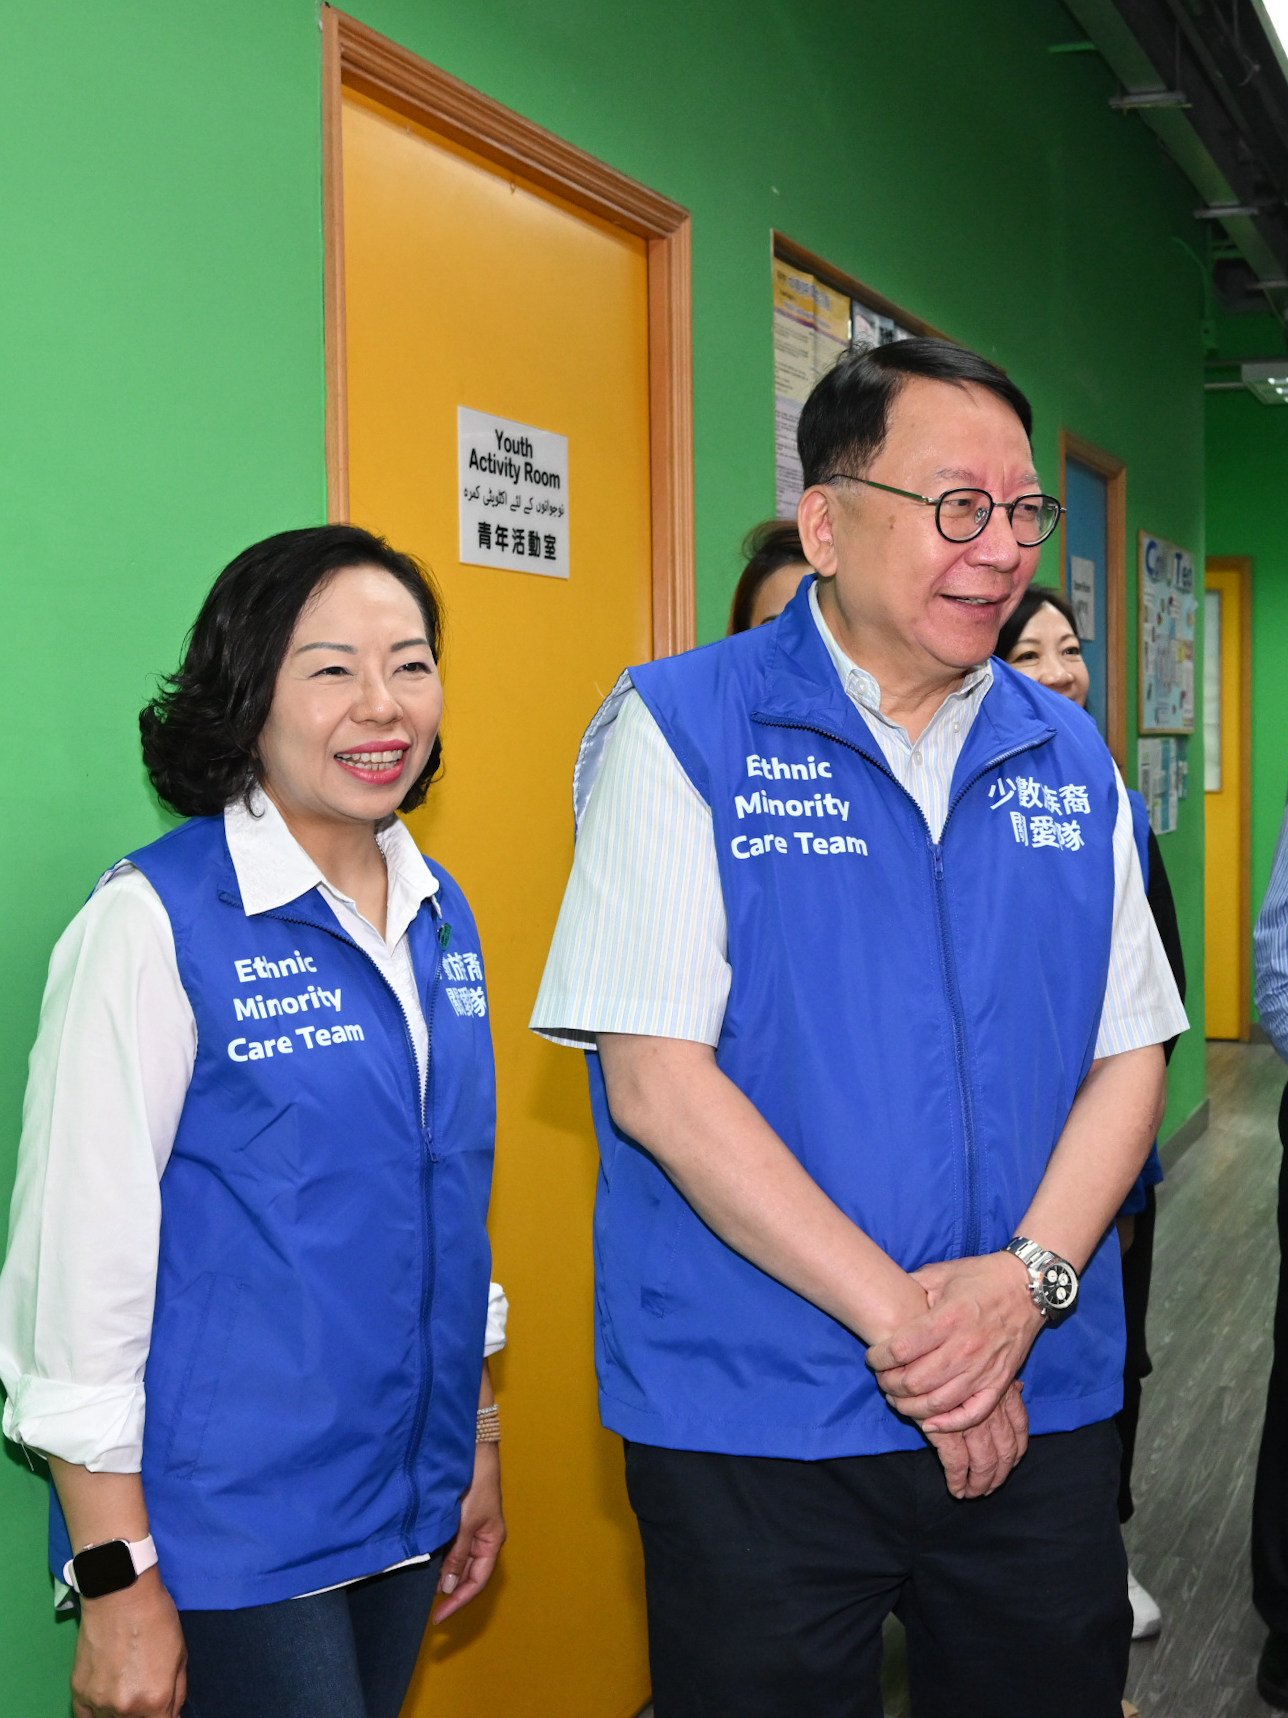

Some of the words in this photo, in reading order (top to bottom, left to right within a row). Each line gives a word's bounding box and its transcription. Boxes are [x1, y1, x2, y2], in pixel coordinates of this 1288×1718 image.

[495, 429, 533, 458] Youth
[469, 448, 520, 485] Activity
[524, 462, 560, 489] Room
[477, 521, 557, 561] 青年活動室
[746, 754, 832, 780] Ethnic
[734, 790, 850, 822] Minority
[731, 833, 788, 860] Care
[793, 832, 868, 857] Team
[234, 950, 318, 983] Ethnic
[233, 985, 342, 1022] Minority
[227, 1035, 294, 1063] Care
[295, 1023, 365, 1050] Team
